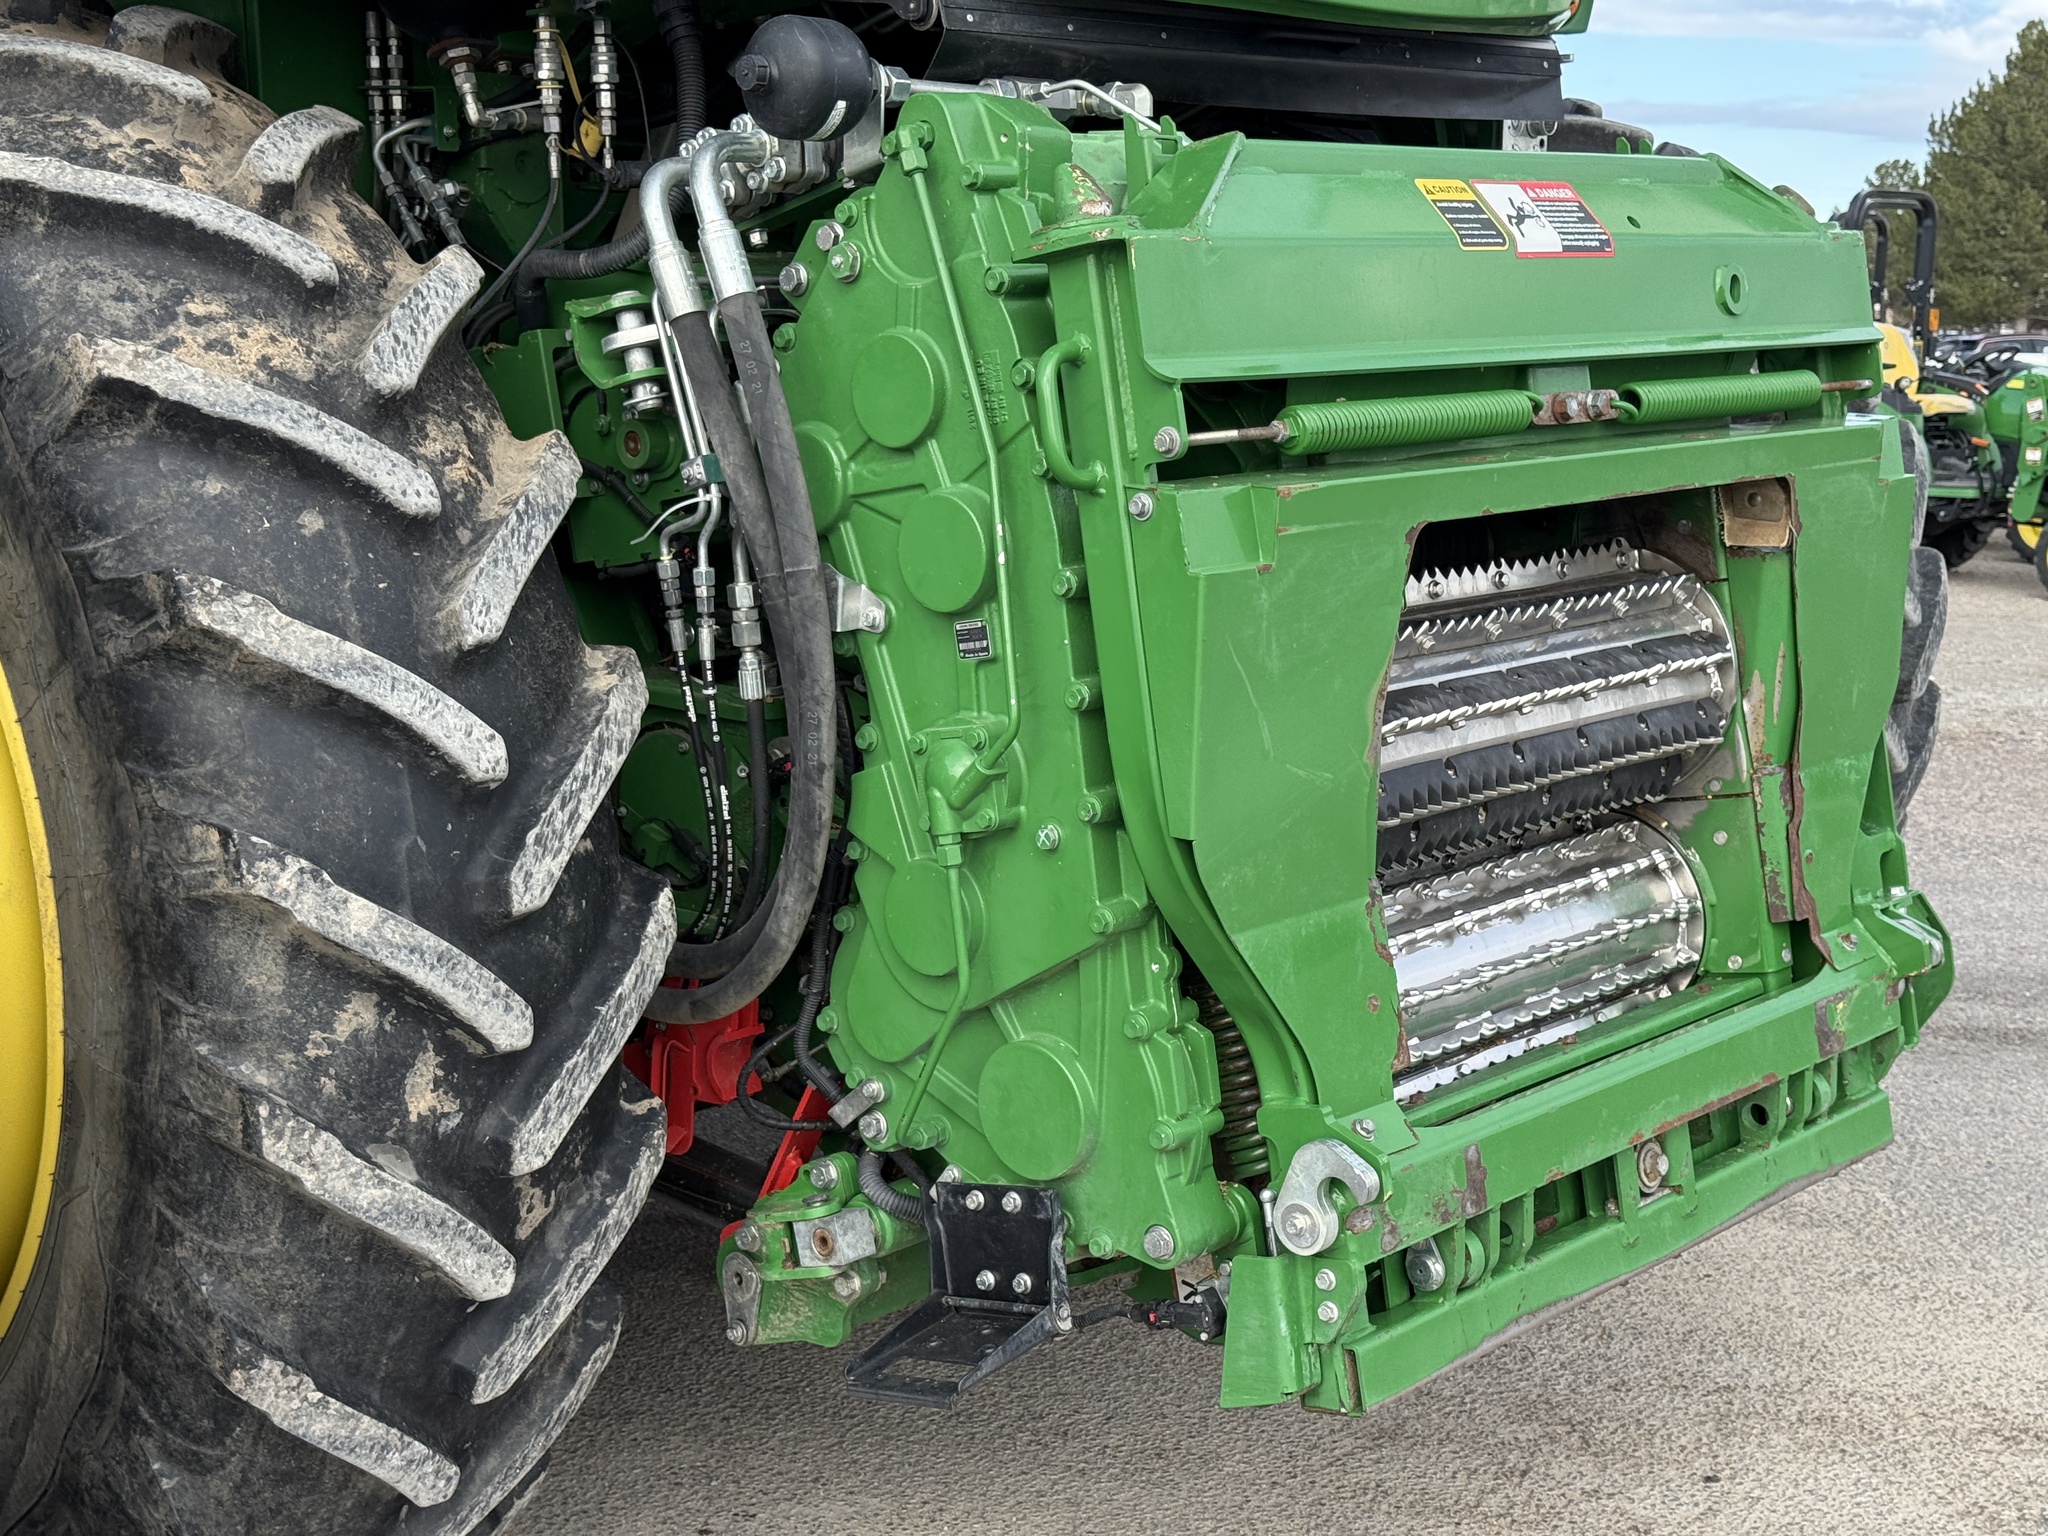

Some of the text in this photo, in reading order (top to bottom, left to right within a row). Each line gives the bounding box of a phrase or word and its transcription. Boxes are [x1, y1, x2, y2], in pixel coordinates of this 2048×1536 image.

[1432, 186, 1469, 194] CAUTION
[1534, 188, 1576, 198] DANGER
[740, 340, 763, 394] 27 02 21
[808, 712, 818, 765] 27 02 21
